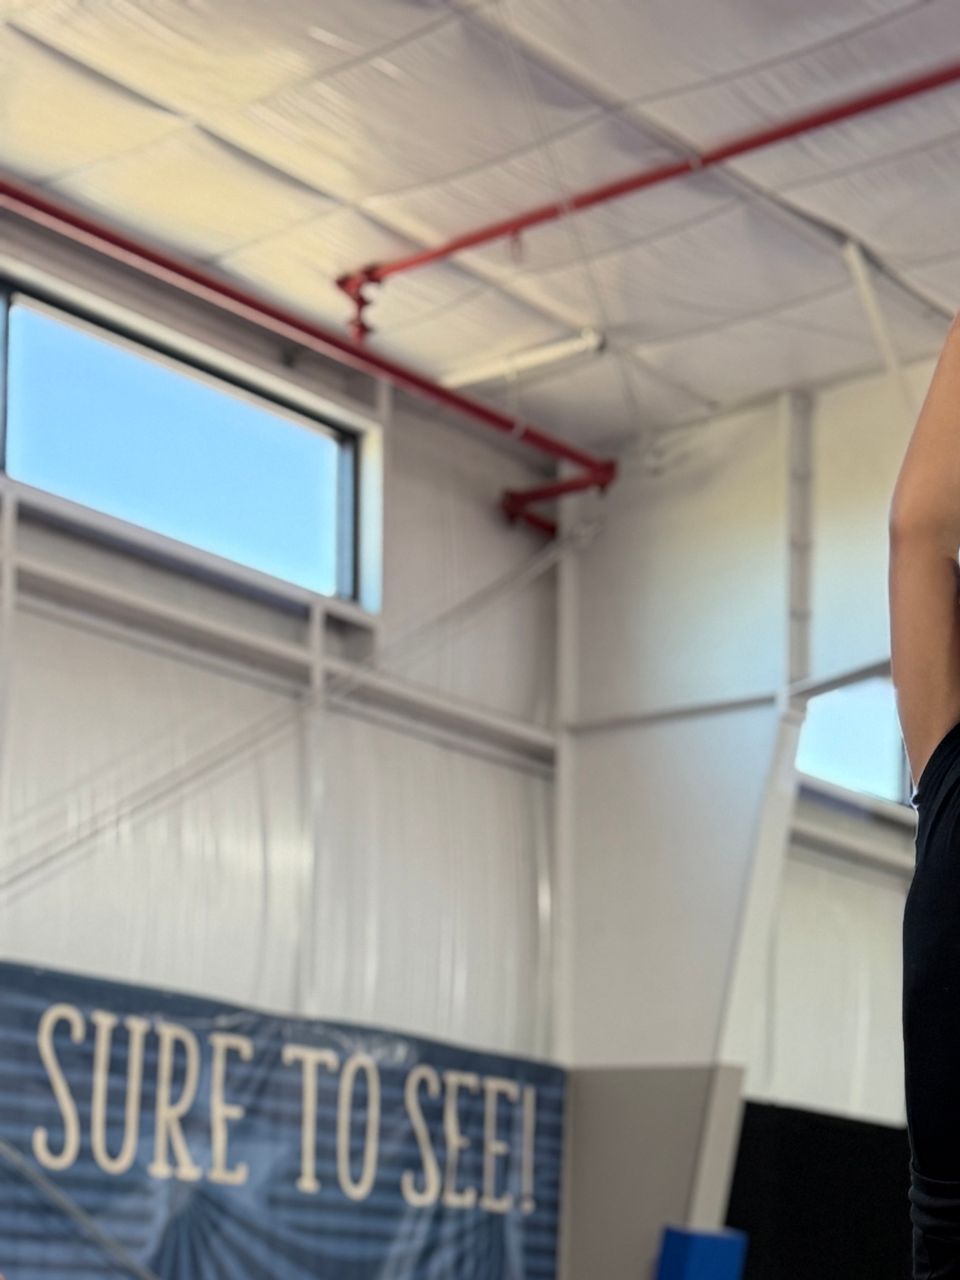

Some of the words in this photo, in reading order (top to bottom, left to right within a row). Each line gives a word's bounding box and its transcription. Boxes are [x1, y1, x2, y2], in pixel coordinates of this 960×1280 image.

[31, 1002, 255, 1186] SURE
[281, 1042, 382, 1201] TO
[401, 1063, 536, 1215] SEE!
